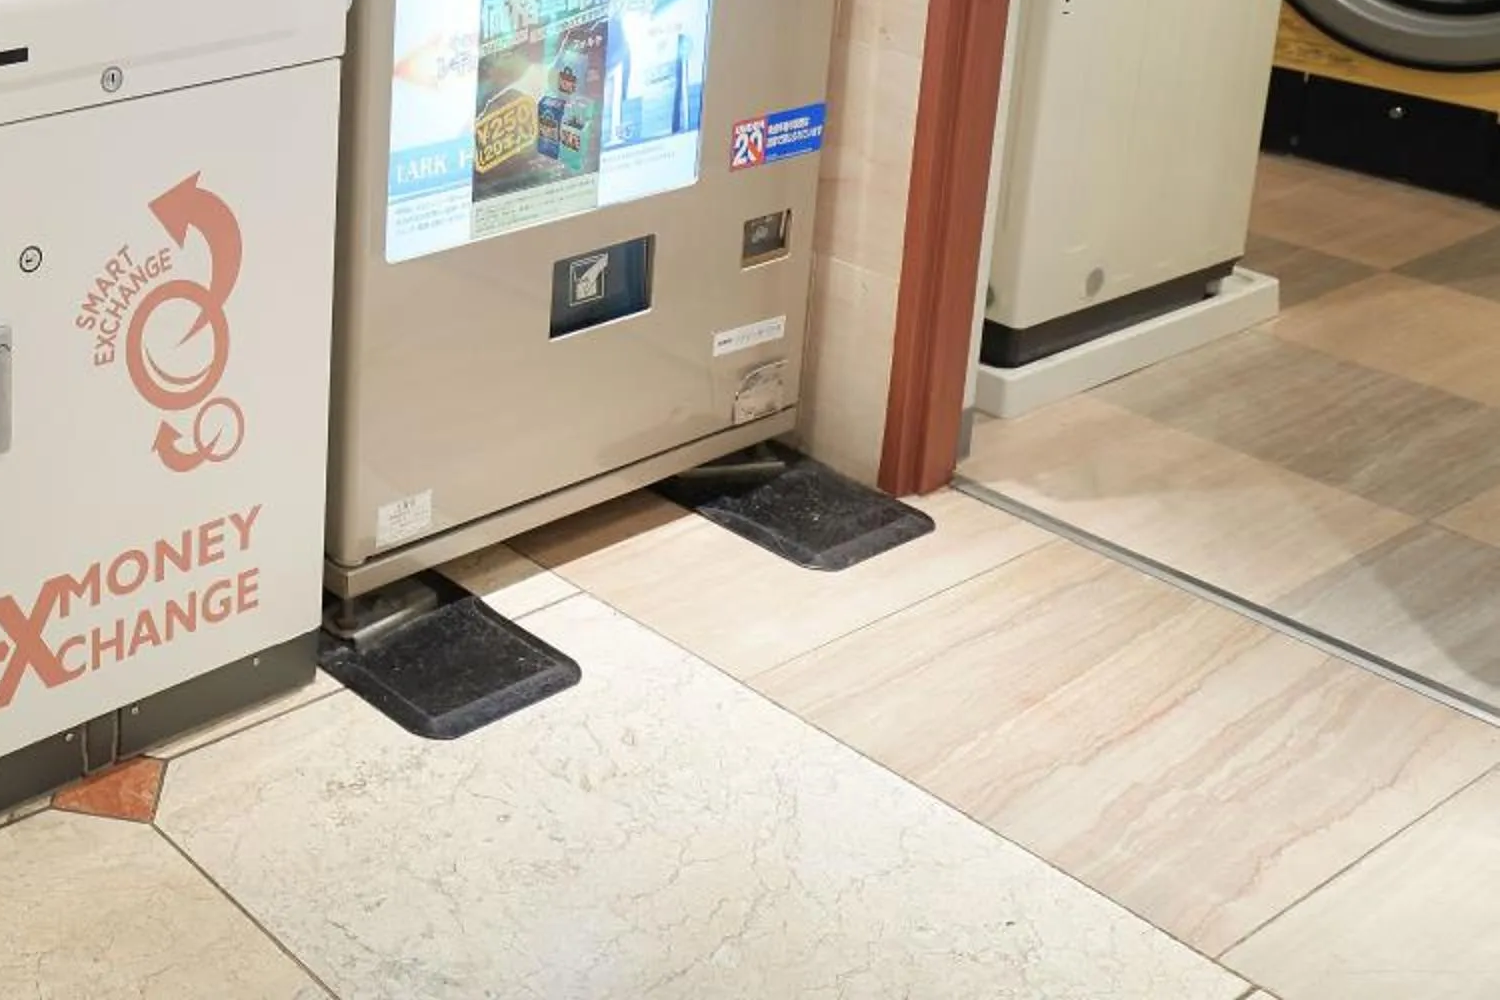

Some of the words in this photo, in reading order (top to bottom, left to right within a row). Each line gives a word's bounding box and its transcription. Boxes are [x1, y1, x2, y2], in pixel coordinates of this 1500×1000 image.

[397, 153, 448, 184] LARK
[75, 245, 135, 331] SMART
[94, 248, 173, 367] EXCHANGE
[58, 504, 263, 617] MONEY
[55, 568, 260, 678] CHANGE
